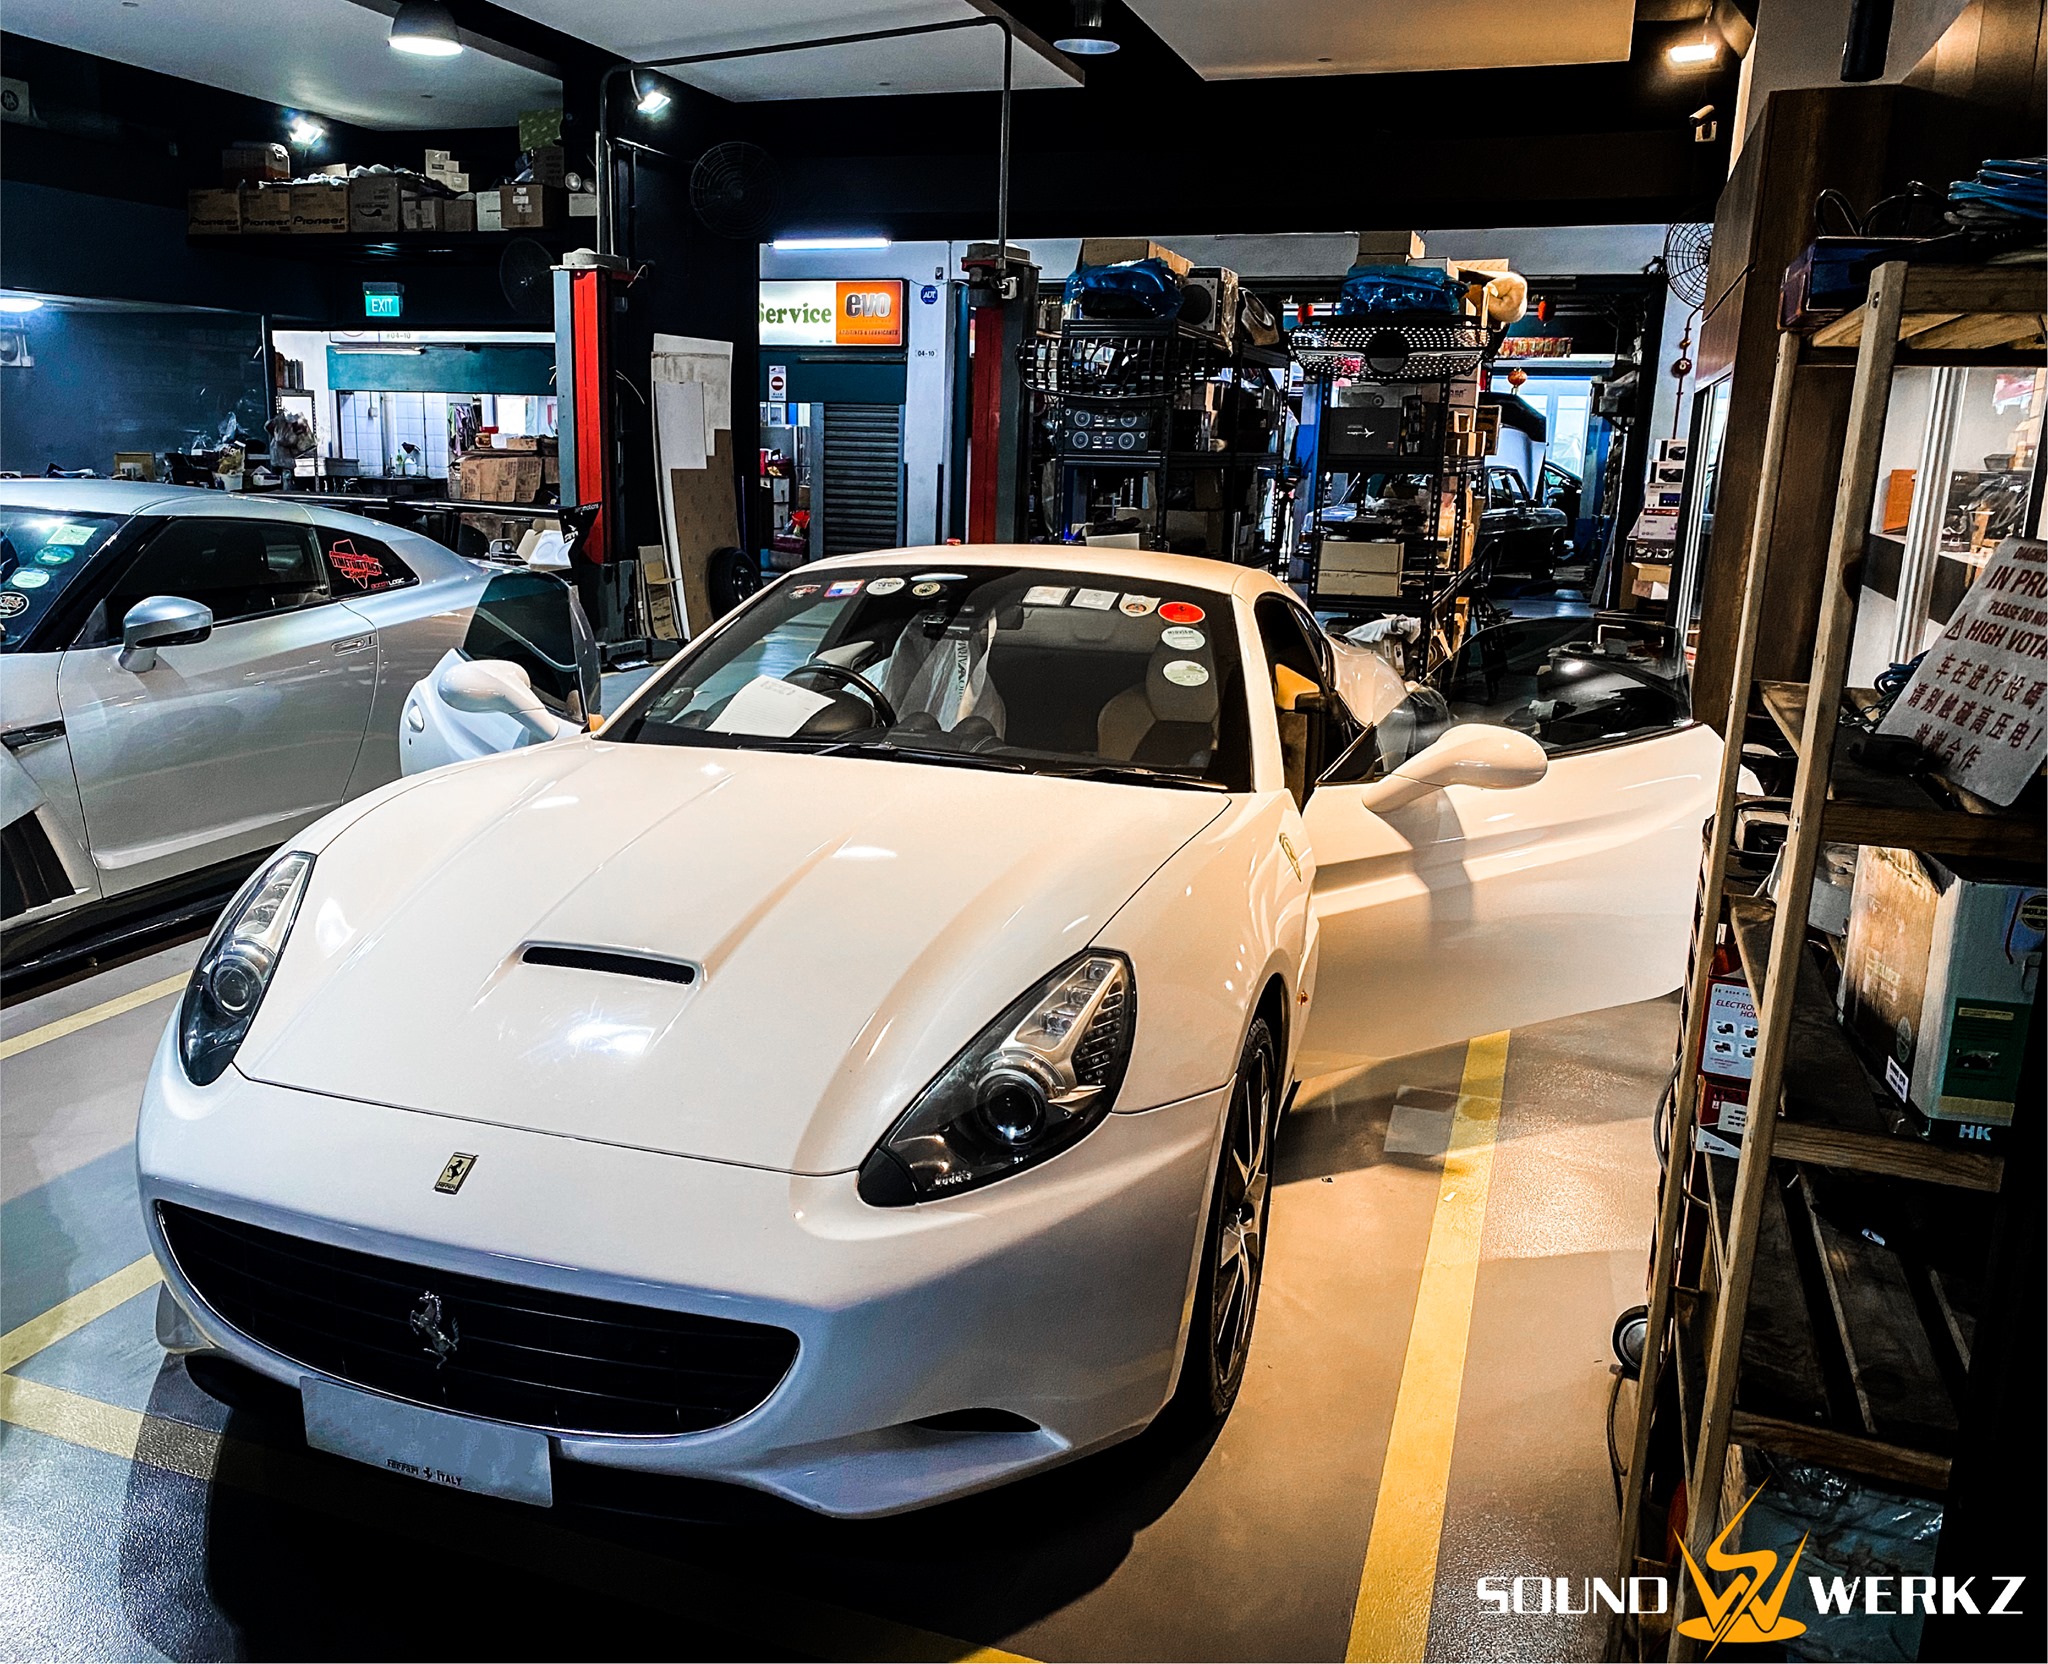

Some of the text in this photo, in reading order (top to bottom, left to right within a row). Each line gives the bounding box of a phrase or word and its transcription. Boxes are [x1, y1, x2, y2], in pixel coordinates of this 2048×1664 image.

[293, 215, 345, 225] Pioneer
[922, 291, 937, 299] ADT
[371, 298, 393, 312] EXIT
[846, 293, 891, 318] evo
[1985, 565, 2015, 591] IN
[1987, 601, 2020, 620] PLEASE
[1964, 619, 2010, 648] HIGH
[1958, 1124, 1992, 1142] HK
[386, 1459, 462, 1486] Ferrari ITALY
